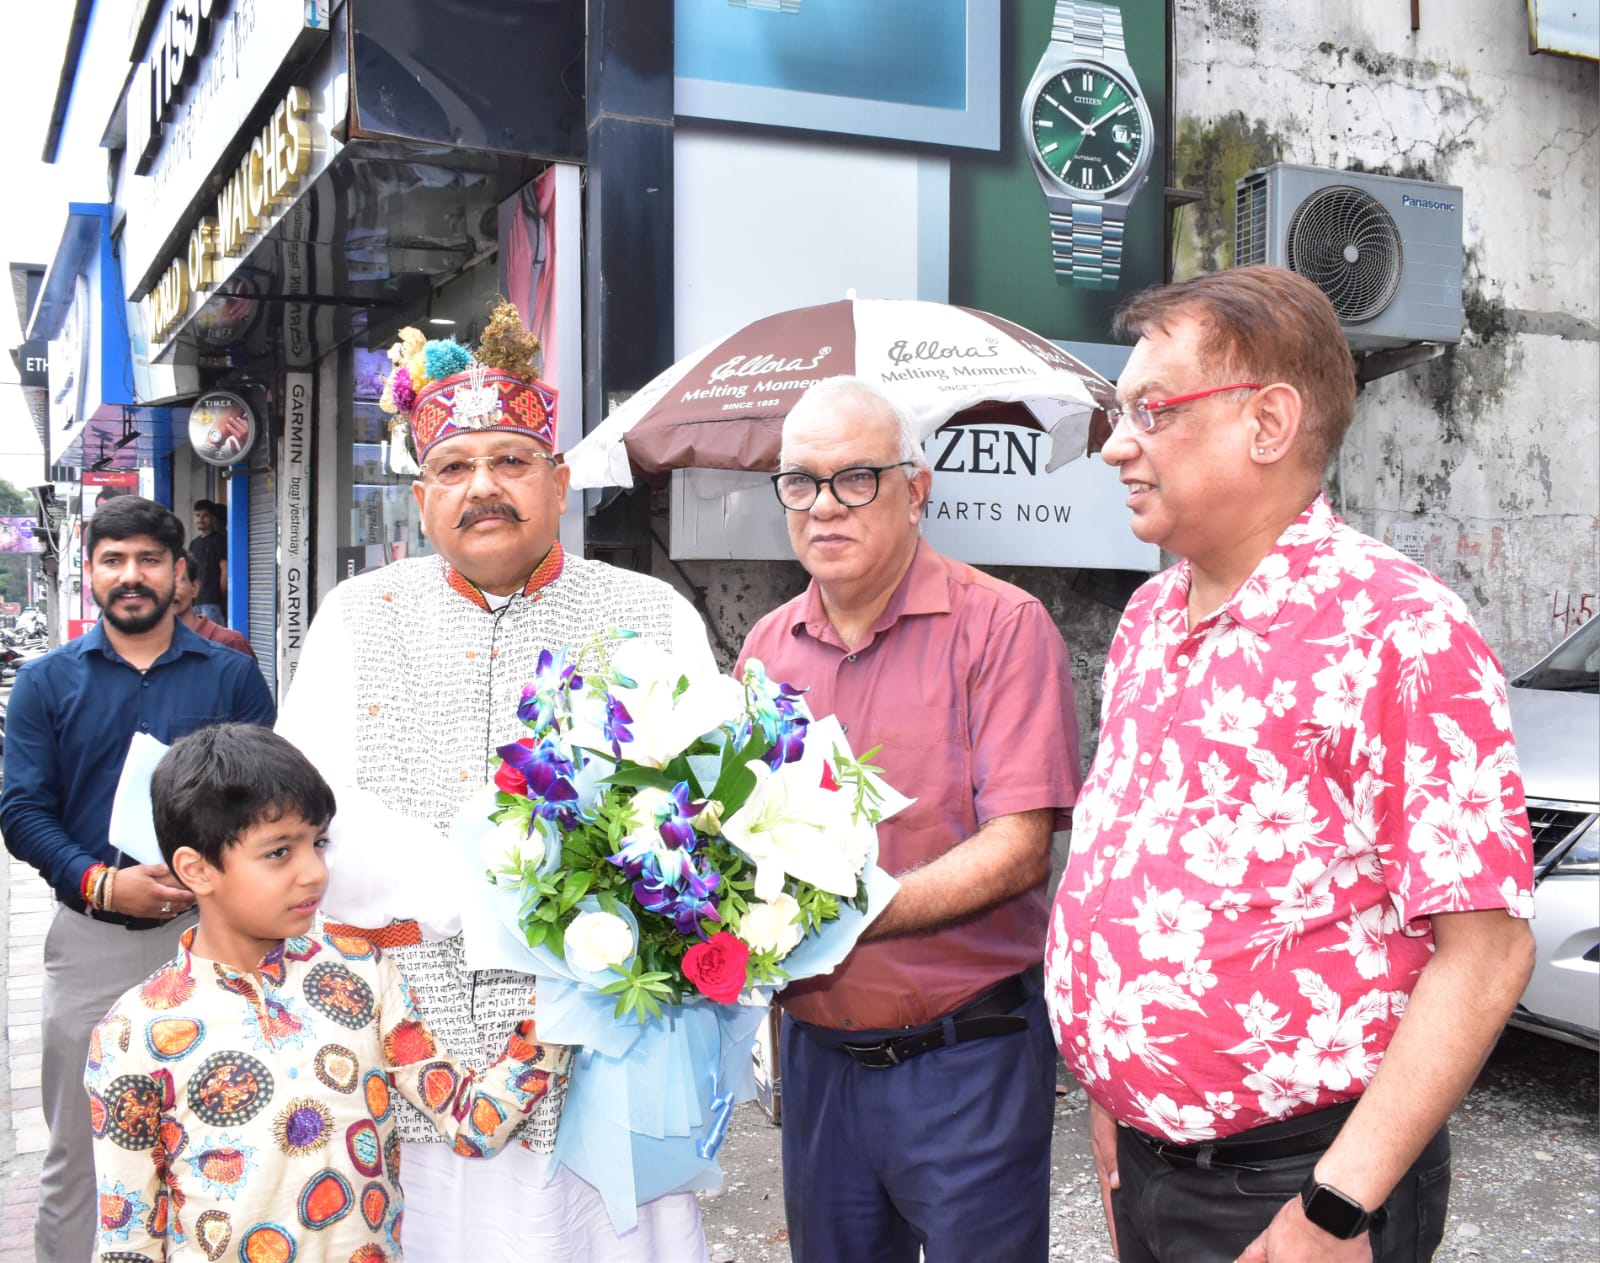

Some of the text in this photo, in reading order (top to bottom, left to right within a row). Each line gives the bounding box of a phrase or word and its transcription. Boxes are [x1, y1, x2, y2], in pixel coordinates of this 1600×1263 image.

[150, 0, 213, 124] TISS
[1073, 96, 1103, 106] CITIZEN
[147, 256, 188, 345] WORLD
[188, 214, 217, 294] OF
[217, 85, 309, 256] WATCHES
[1402, 194, 1456, 211] Panasonic
[880, 364, 1037, 384] Melting Moments
[680, 384, 748, 403] Melting
[753, 376, 822, 393] Momen
[937, 383, 969, 392] SINCE
[204, 400, 232, 408] TIMEX
[721, 402, 753, 411] SINCE
[289, 384, 305, 464] GARMIN
[921, 426, 1042, 477] ZEN
[290, 476, 302, 501] beat
[923, 500, 1072, 524] TARTS NOW
[287, 501, 301, 558] yesterday.
[287, 567, 301, 650] GARMIN
